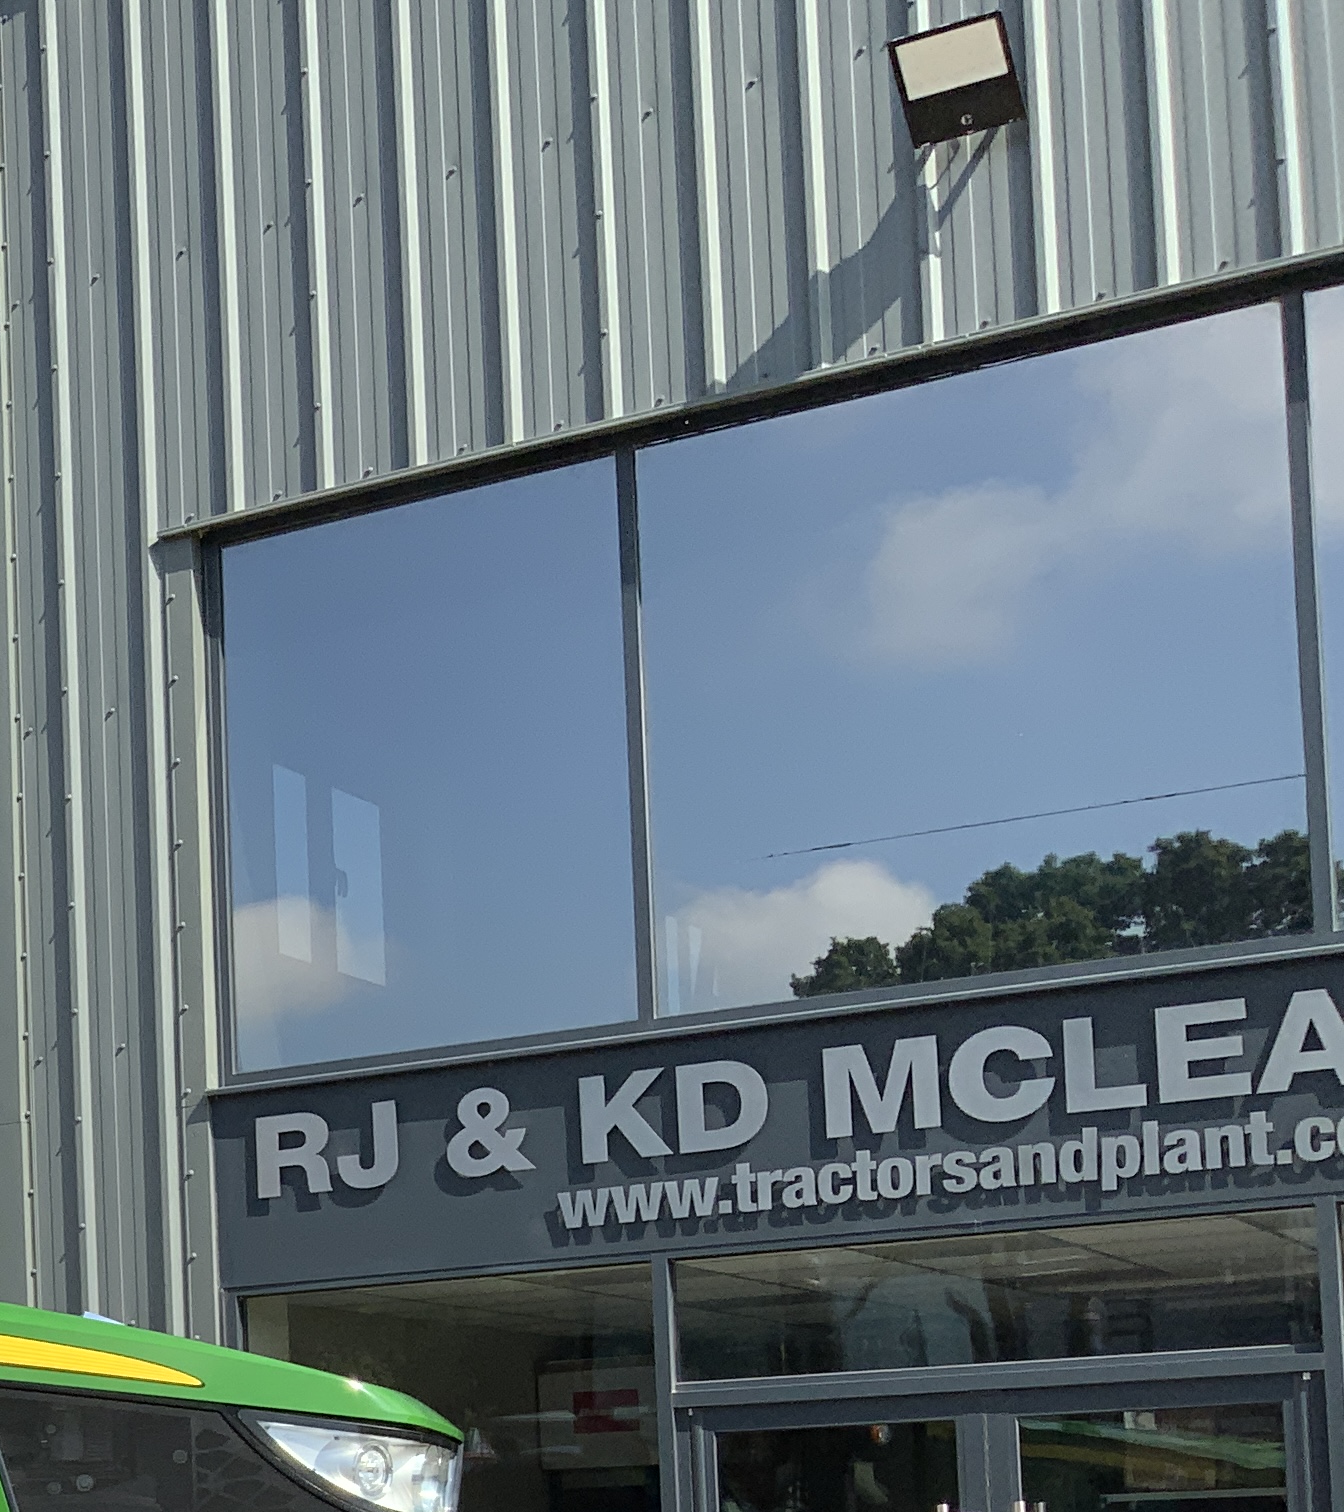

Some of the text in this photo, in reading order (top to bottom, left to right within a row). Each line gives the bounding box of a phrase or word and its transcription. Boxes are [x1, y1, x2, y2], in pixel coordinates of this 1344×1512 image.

[254, 988, 1344, 1199] RJ & KD MCLEA
[558, 1110, 1344, 1230] www.tractorsandplant.c
